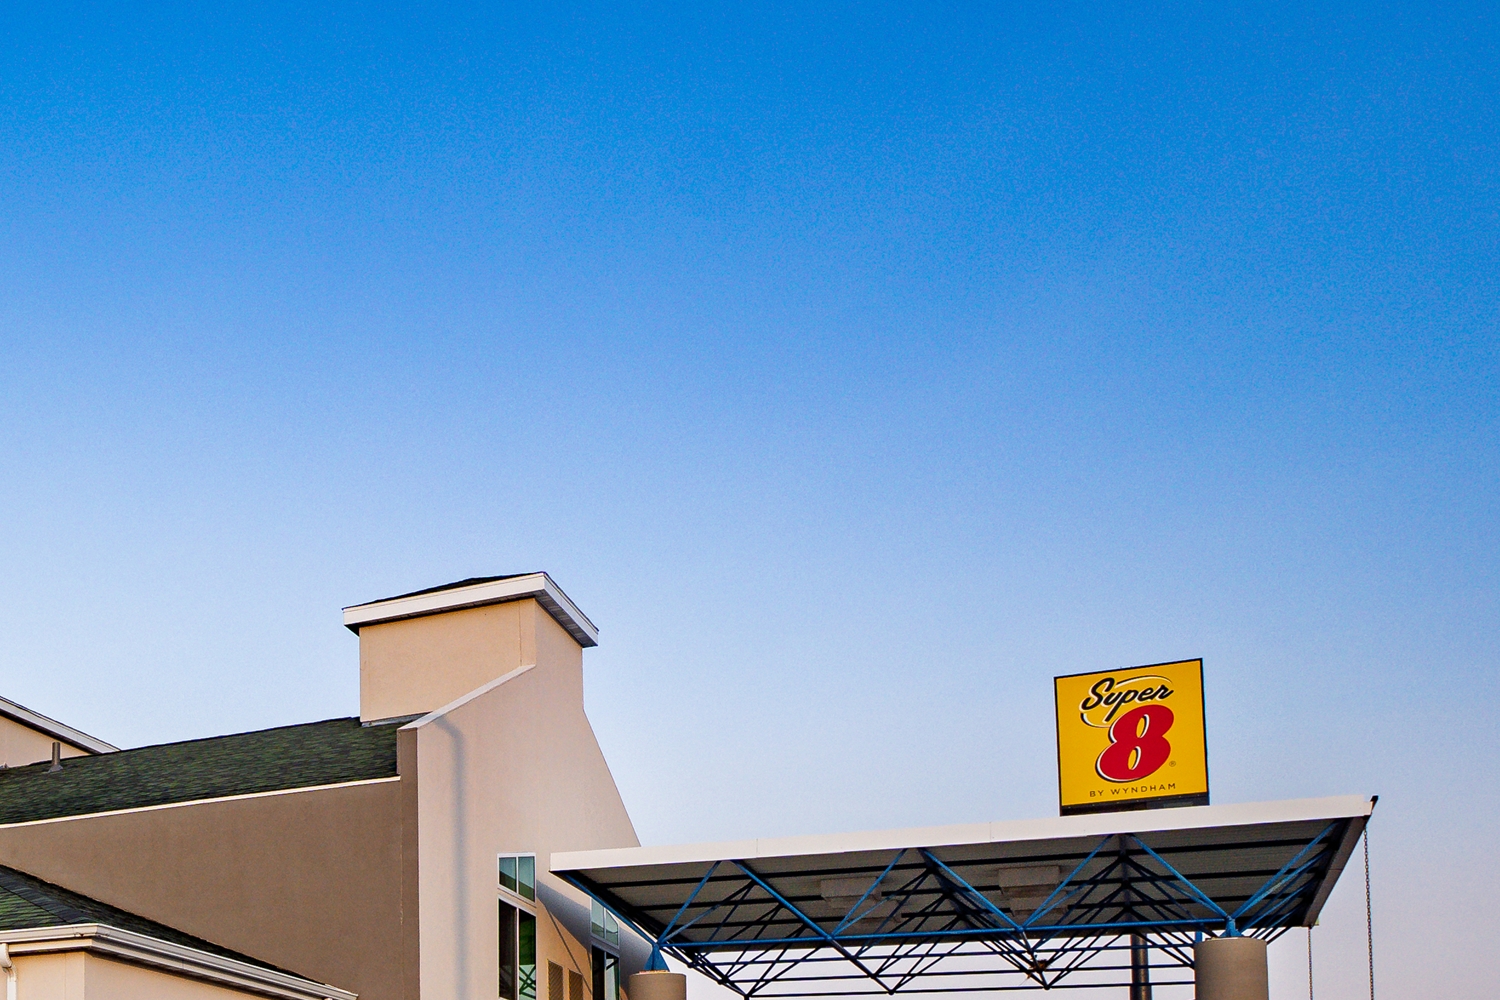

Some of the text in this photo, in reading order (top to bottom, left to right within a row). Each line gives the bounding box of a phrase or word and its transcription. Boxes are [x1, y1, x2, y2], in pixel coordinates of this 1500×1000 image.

[1079, 675, 1175, 724] Super
[1095, 704, 1175, 783] 8
[1089, 782, 1176, 798] BY WYNDHAM
